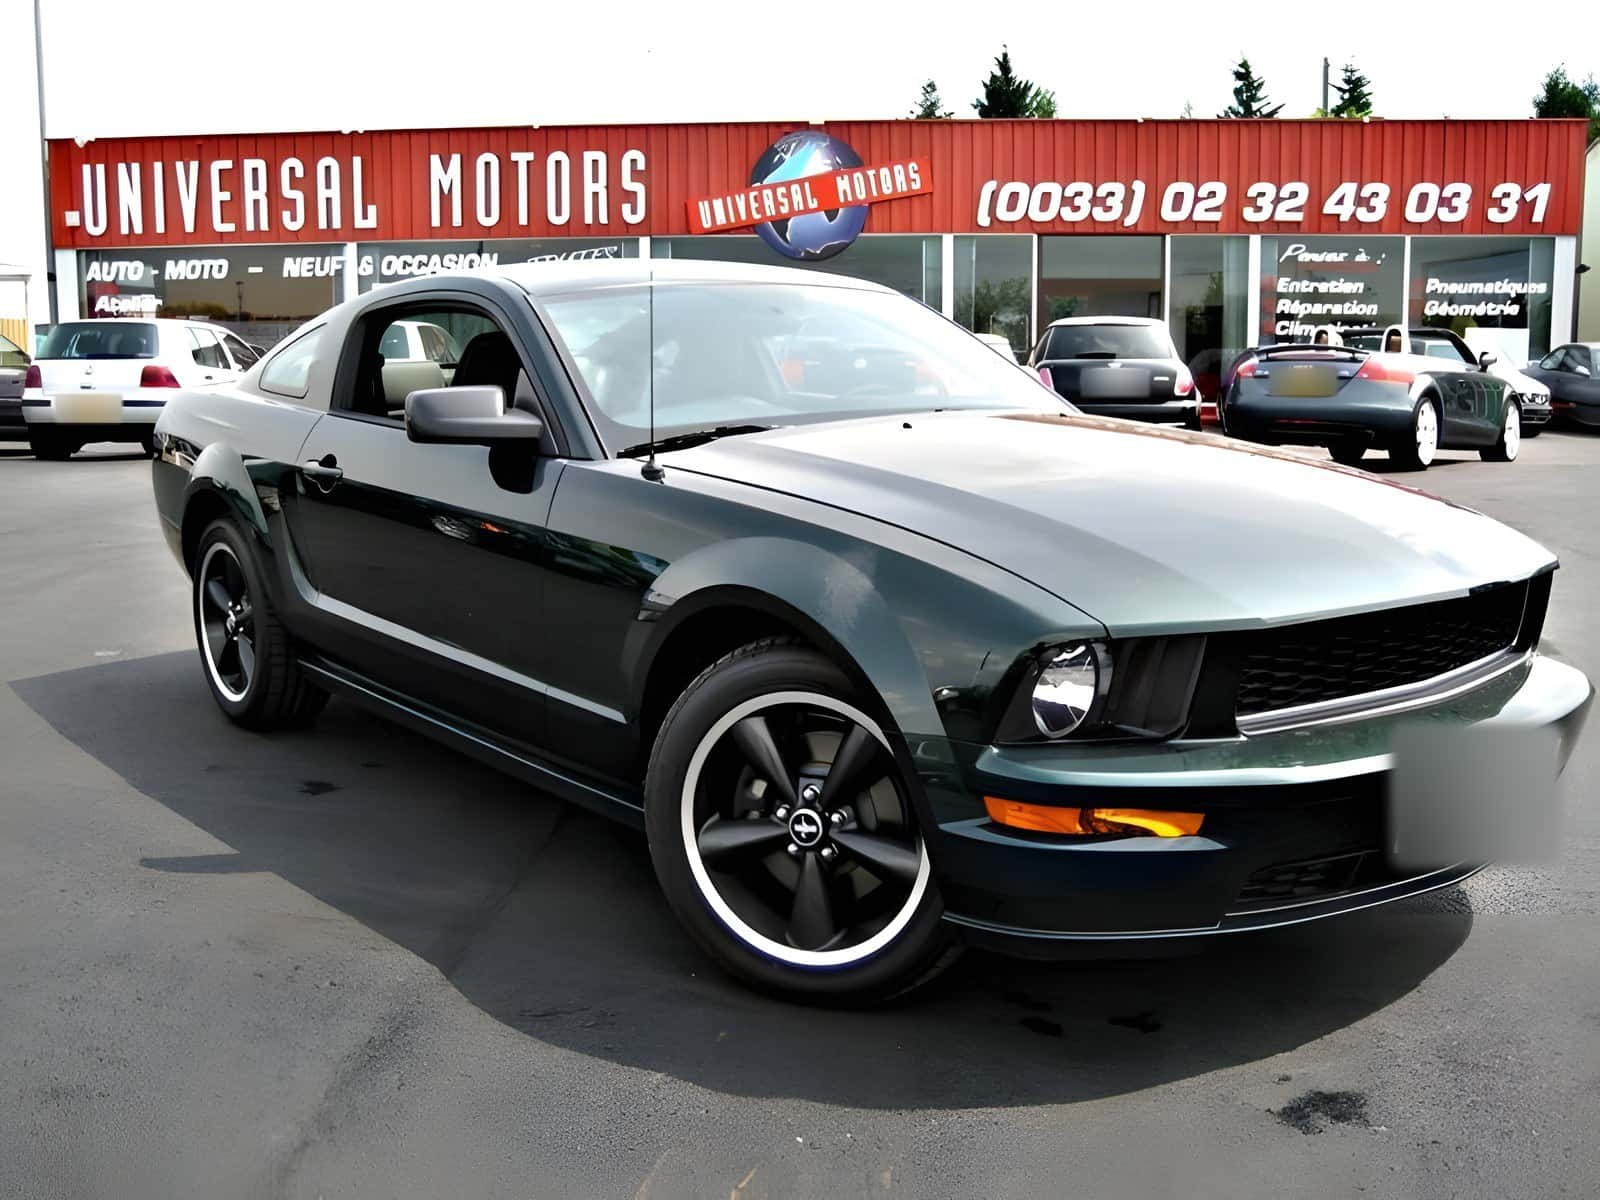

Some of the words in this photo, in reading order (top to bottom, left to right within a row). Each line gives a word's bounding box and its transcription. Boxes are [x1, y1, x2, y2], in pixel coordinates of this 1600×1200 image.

[82, 154, 378, 237] UNIVERSAL
[430, 149, 648, 228] MOTORS
[698, 178, 818, 230] UNIVERSAL
[836, 160, 923, 204] MOTORS
[976, 179, 1146, 227] (0033)
[1160, 181, 1228, 223] 02
[1242, 182, 1310, 223] 32
[1323, 182, 1390, 223] 43
[1404, 182, 1472, 223] 03
[1487, 183, 1552, 223] 31
[86, 260, 144, 282] AUTO
[164, 258, 229, 280] MOTO
[282, 256, 345, 278] NEUF
[358, 255, 373, 276] &
[381, 253, 499, 276] OCCASION
[1276, 277, 1365, 294] Entretien
[1425, 278, 1547, 298] Pneumatiques
[1276, 298, 1378, 319] Réparation
